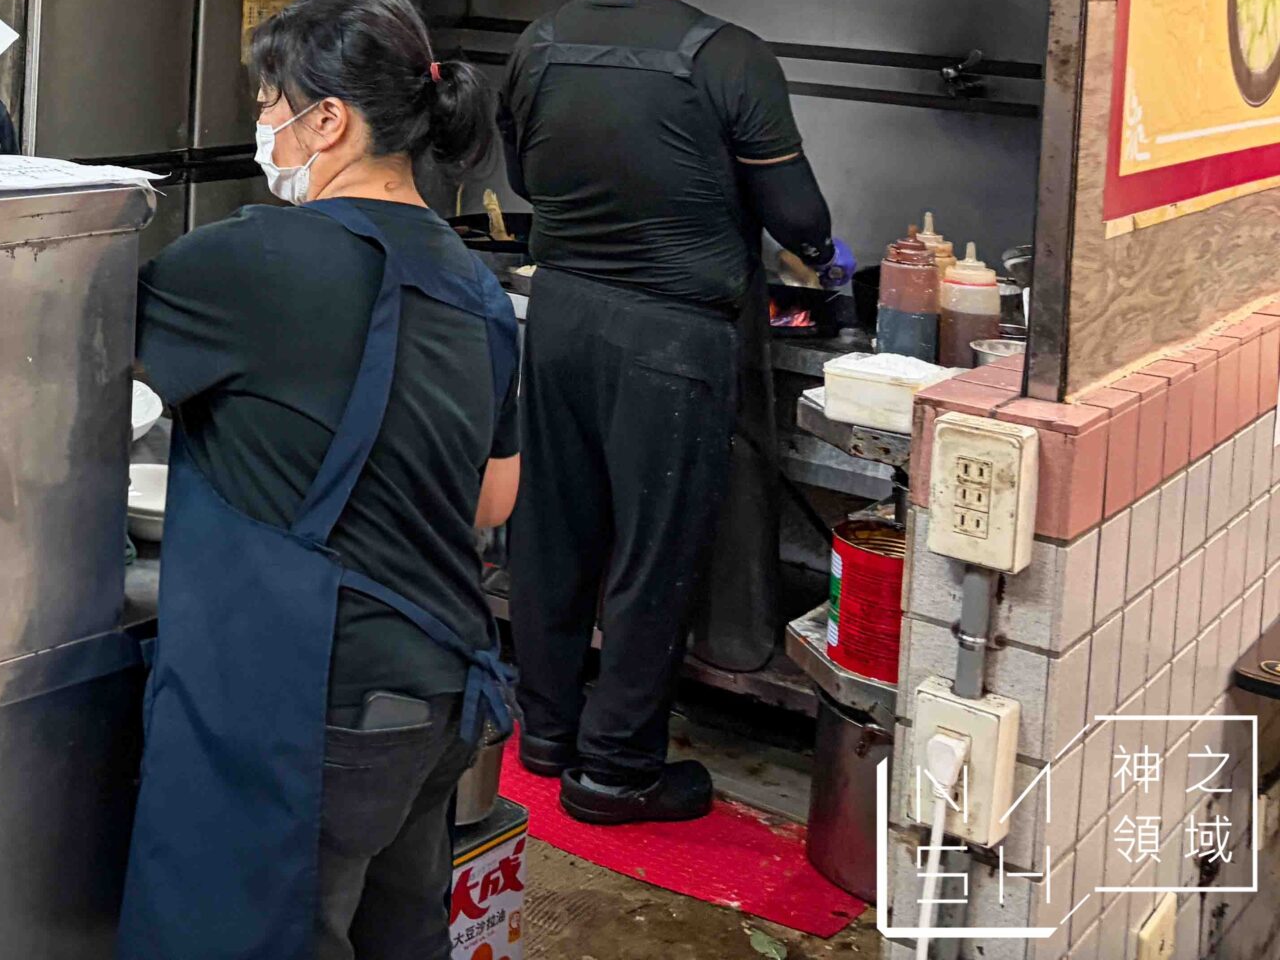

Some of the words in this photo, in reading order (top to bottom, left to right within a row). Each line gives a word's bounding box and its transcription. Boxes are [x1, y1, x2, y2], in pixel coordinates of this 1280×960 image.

[453, 908, 507, 948] 大豆沙拉油
